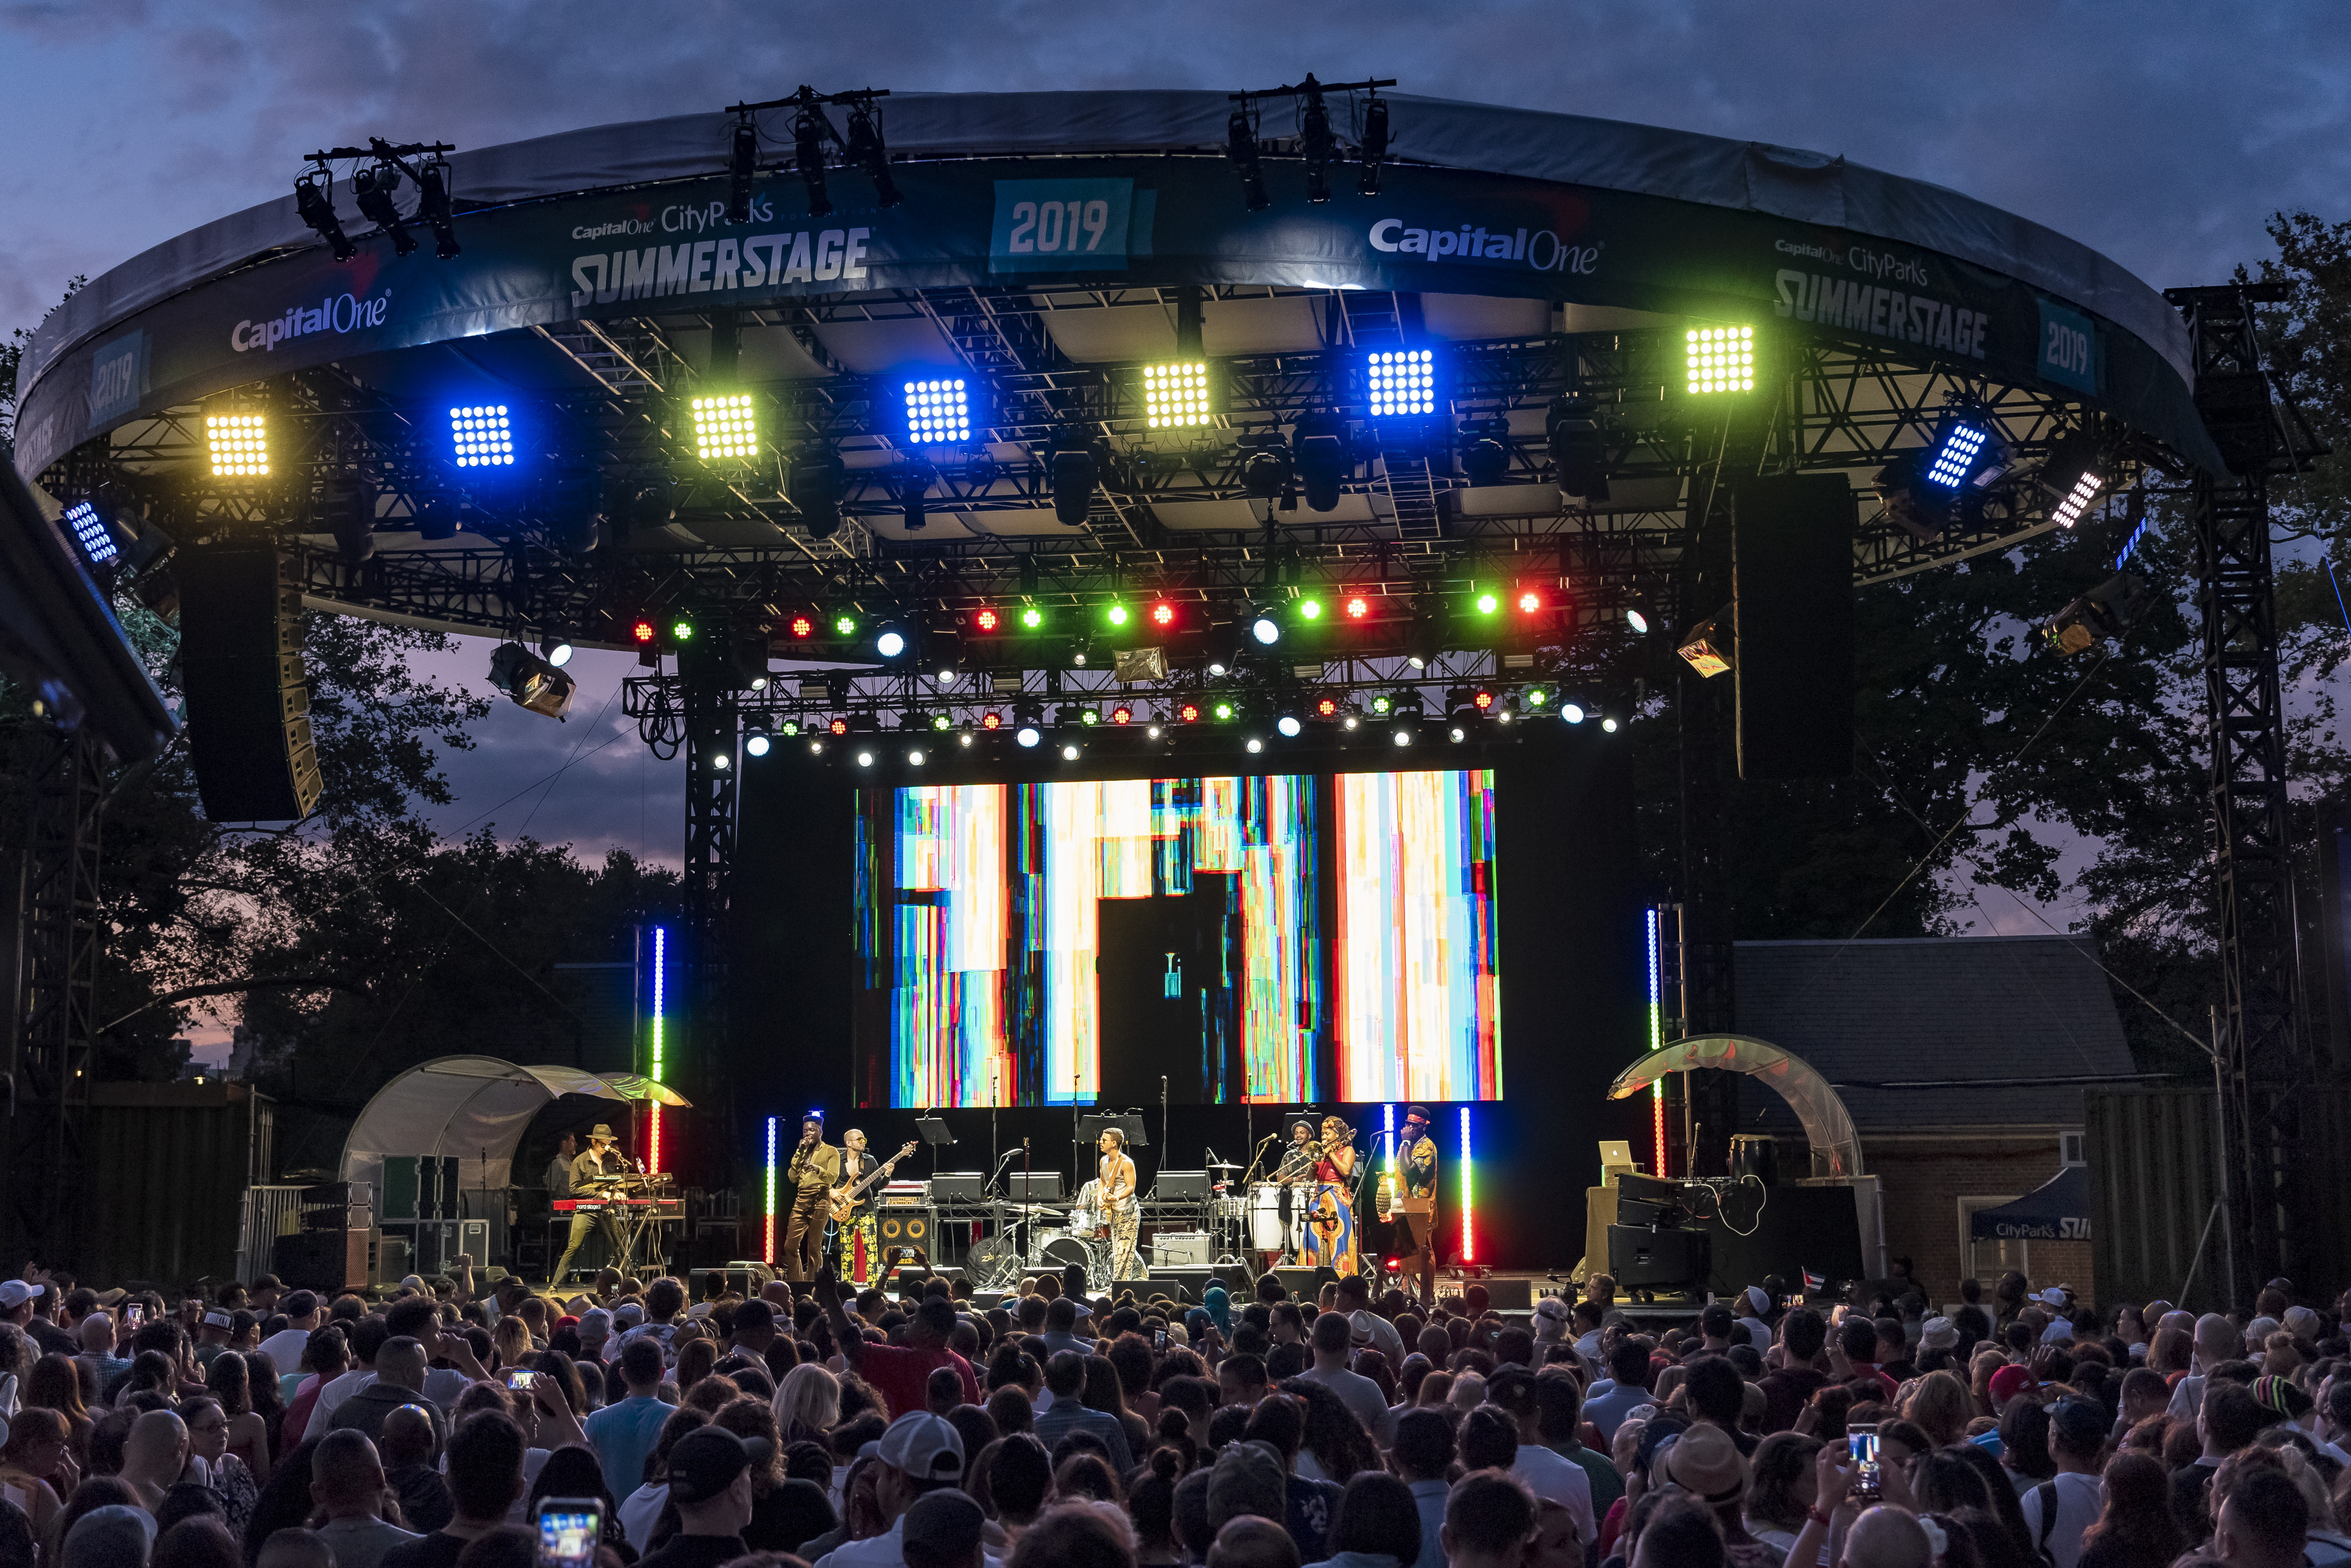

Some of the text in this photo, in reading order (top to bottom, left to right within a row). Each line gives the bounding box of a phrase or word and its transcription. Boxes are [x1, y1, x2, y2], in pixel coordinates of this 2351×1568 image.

[661, 198, 774, 233] CityPks
[1009, 200, 1108, 252] 2019
[572, 227, 870, 307] SUMMERSTAGE
[1849, 246, 1927, 287] CityParks
[1773, 269, 1988, 359] SUMMERSTAGE
[2046, 321, 2087, 374] 2019
[95, 352, 133, 410] 2019
[1996, 1223, 2055, 1238] CityParks
[204, 1312, 231, 1328] BROOKLYN
